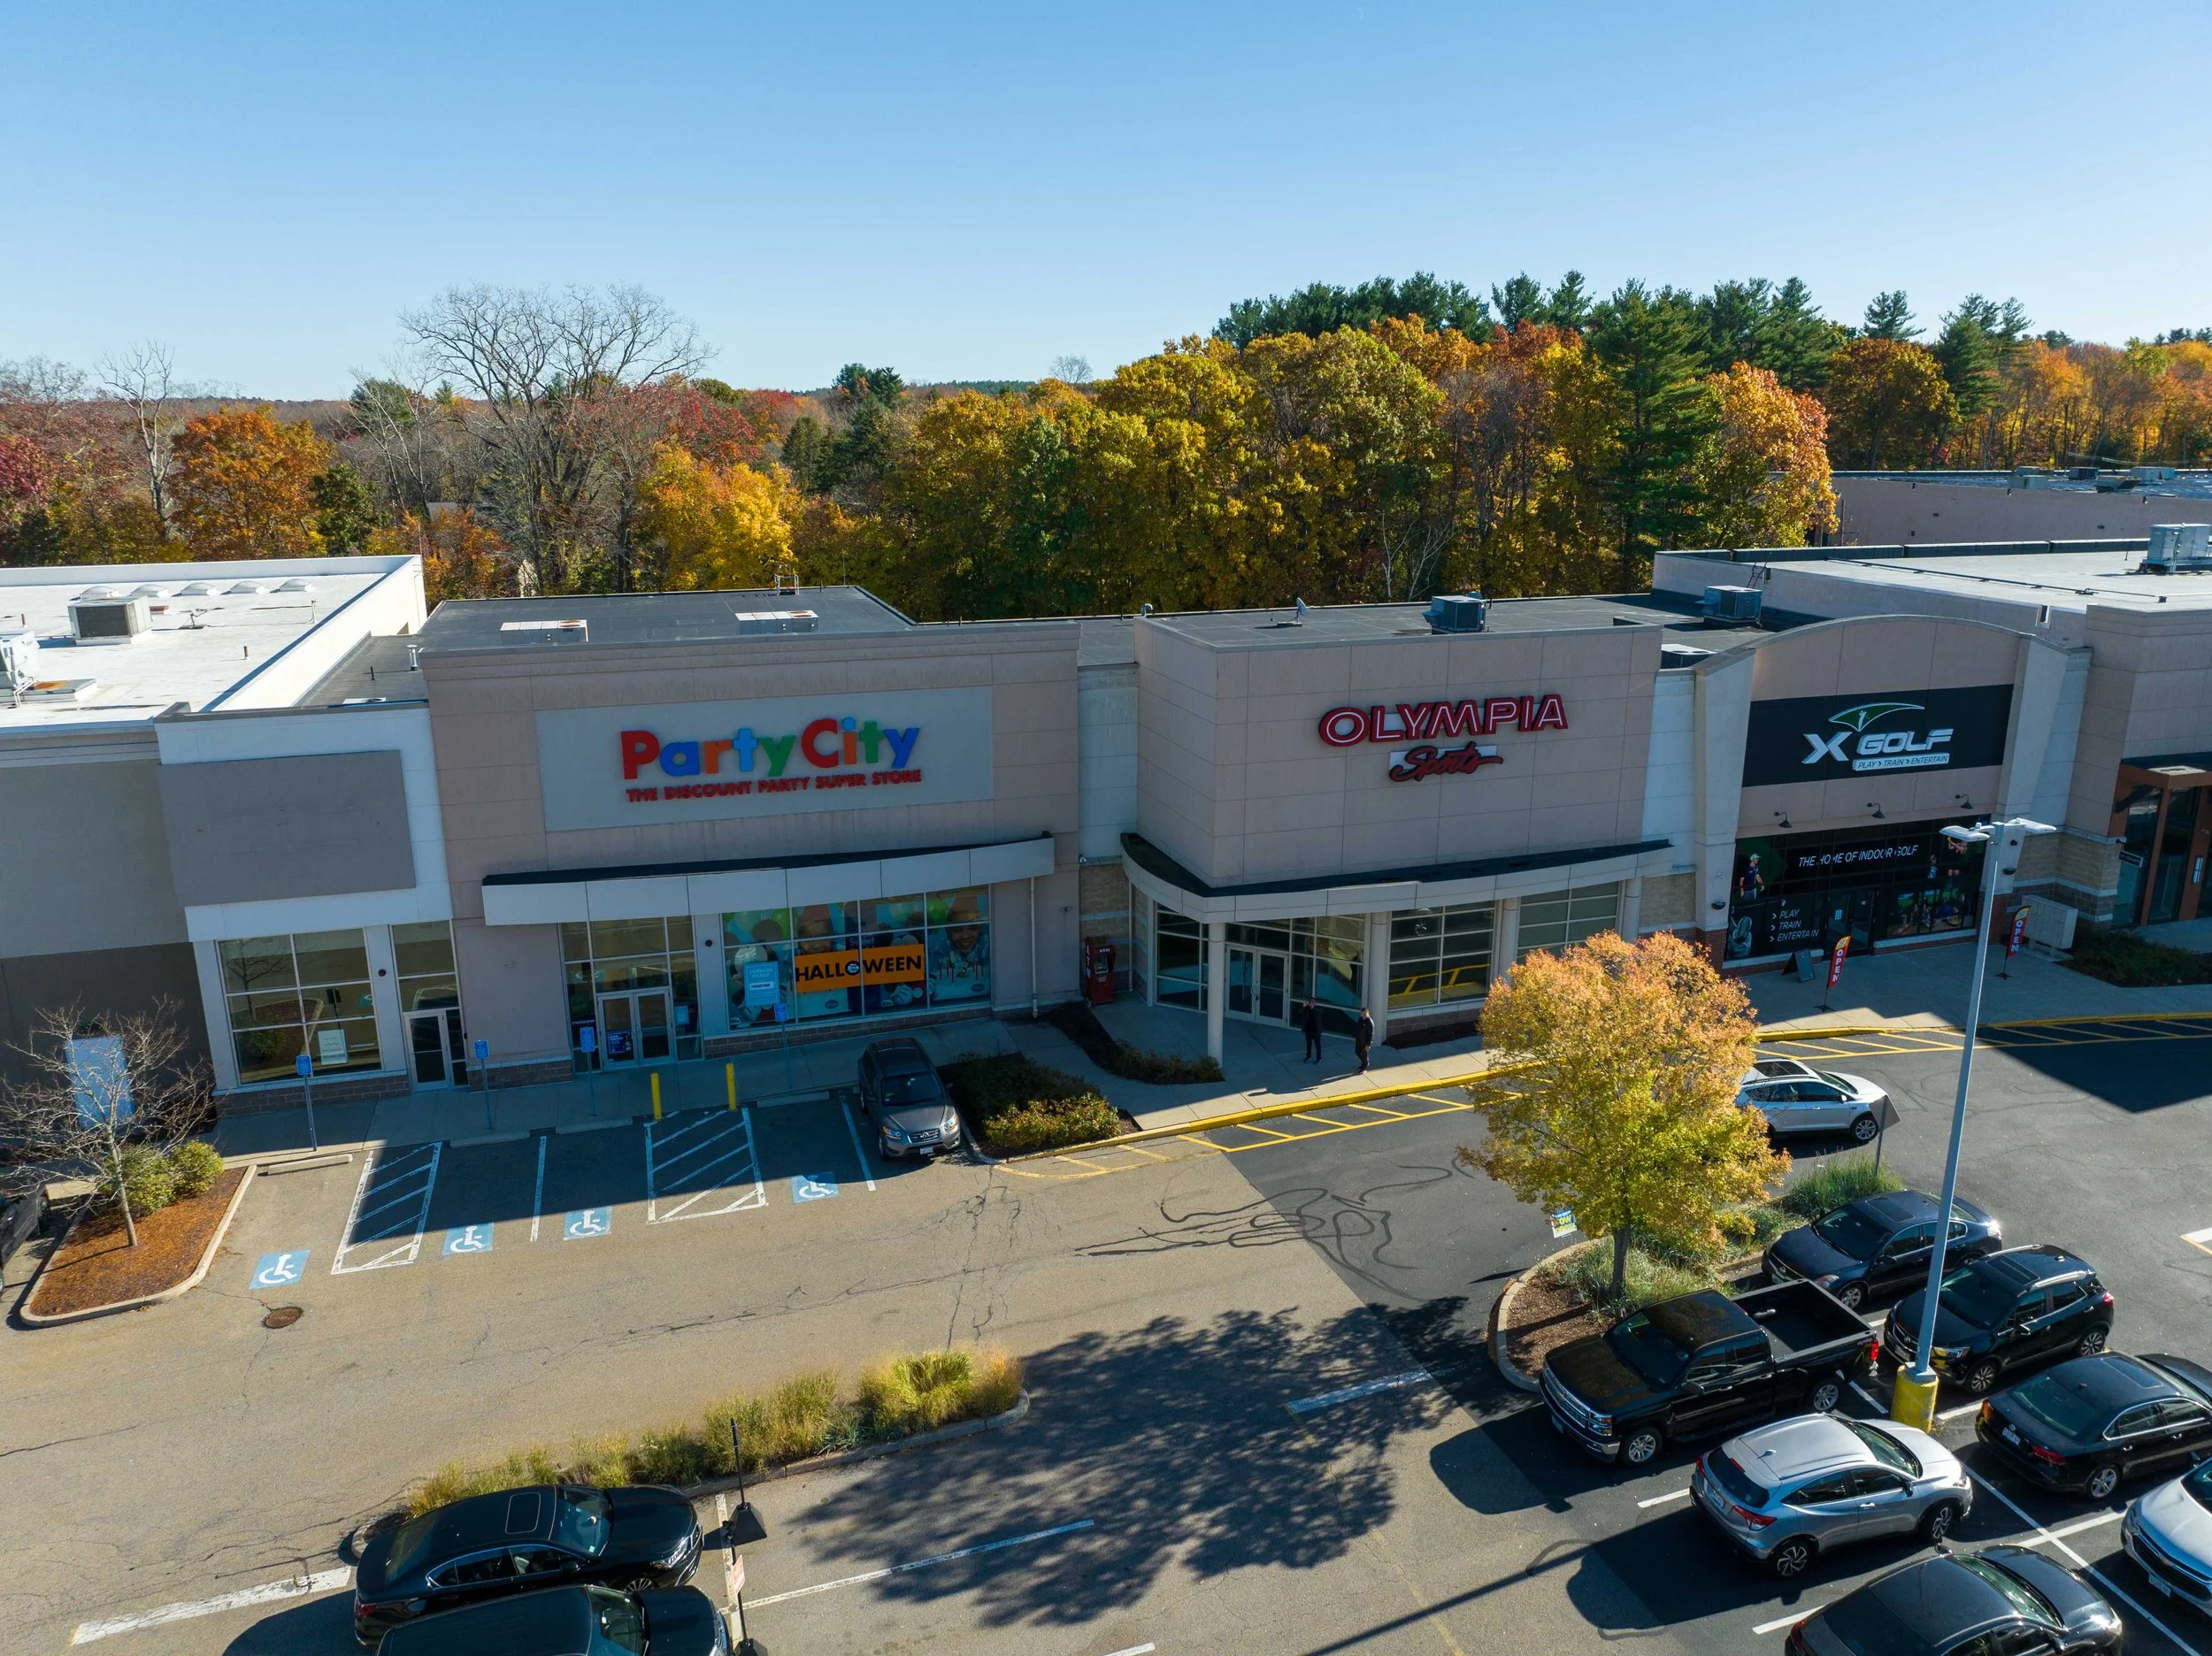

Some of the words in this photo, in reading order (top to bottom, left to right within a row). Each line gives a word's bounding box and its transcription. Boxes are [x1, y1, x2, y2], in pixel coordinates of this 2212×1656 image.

[1318, 694, 1568, 748] OLYMPIA
[619, 727, 795, 779] Party
[801, 717, 921, 770] City
[1388, 740, 1504, 782] Sports
[1801, 731, 1852, 764] X
[1856, 728, 1954, 755] GOLF
[1857, 760, 1877, 770] PLAY
[1883, 757, 1905, 767] TRAIN
[1910, 754, 1948, 765] ENTERTAIN
[626, 786, 658, 802] THE
[664, 780, 752, 800] DISCOUNT
[758, 776, 810, 793] PARTY
[816, 772, 867, 789] SUPER
[872, 768, 922, 786] STORE
[1798, 855, 1816, 868] THE
[1845, 852, 1858, 862] OF
[1858, 847, 1893, 862] INDOOR
[1893, 845, 1919, 856] GOLF
[1778, 920, 1801, 931] TRAIN
[1779, 908, 1800, 919] PLAY
[1777, 929, 1819, 942] ENTERTAIN
[2011, 919, 2024, 952] OPEN
[795, 954, 922, 983] HALLOWEEN
[1832, 948, 1844, 982] OPEN
